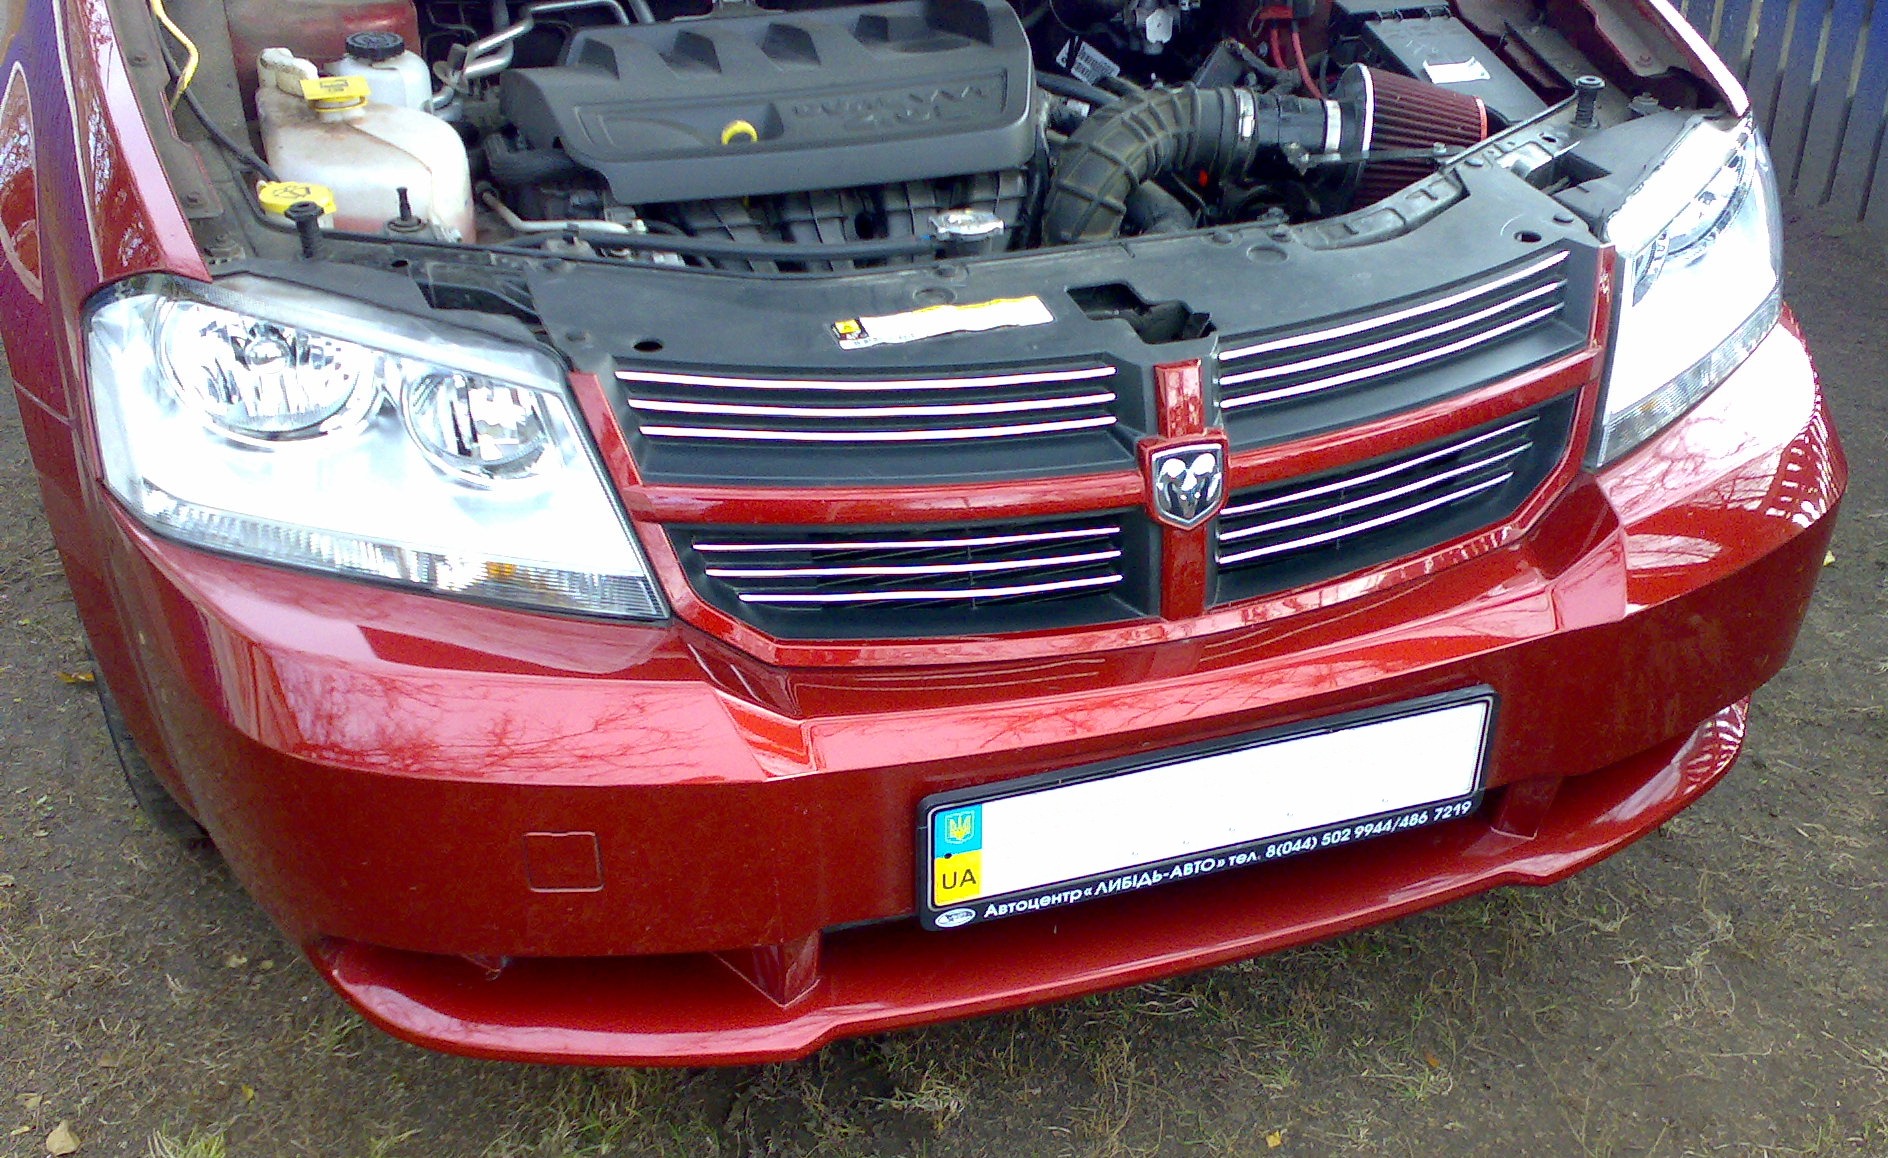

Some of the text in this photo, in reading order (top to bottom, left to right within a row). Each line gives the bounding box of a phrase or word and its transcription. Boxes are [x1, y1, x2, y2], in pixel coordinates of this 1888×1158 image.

[942, 868, 977, 890] UA
[983, 890, 1082, 917] Автоцентр
[1228, 851, 1260, 865] тел.
[1266, 837, 1317, 858] 8(044)
[1321, 828, 1351, 847] 502
